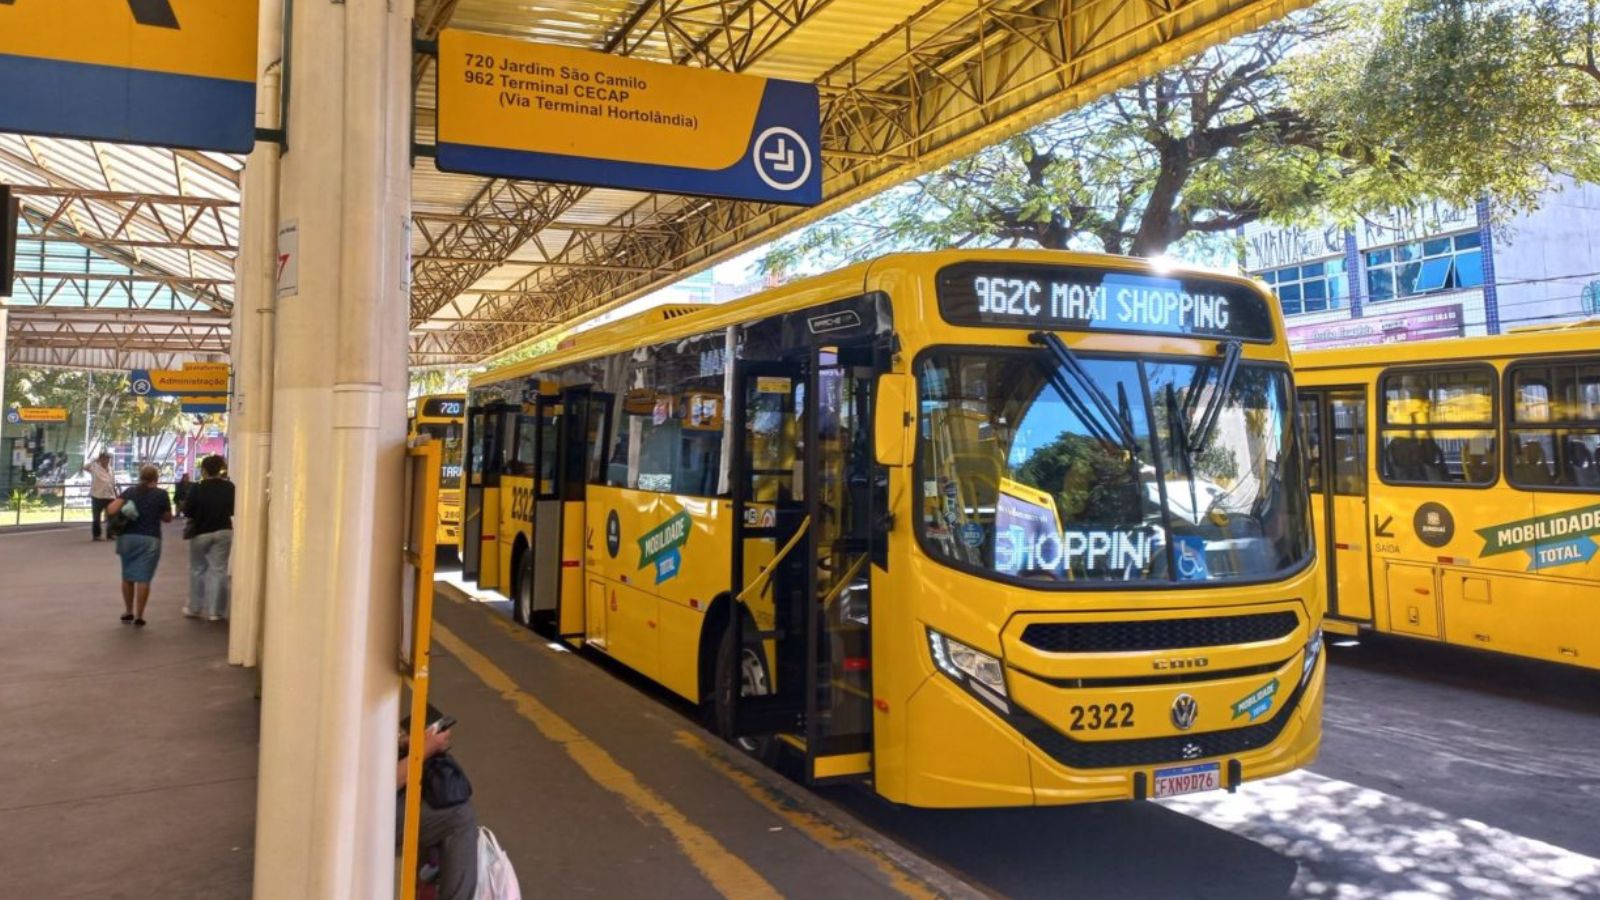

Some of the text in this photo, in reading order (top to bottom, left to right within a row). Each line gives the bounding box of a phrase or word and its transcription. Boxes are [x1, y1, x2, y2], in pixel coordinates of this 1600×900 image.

[464, 70, 630, 103] 962 Terminal CECAP
[465, 53, 648, 90] 720 Jardim São Camilo
[499, 91, 698, 130] (Via Terminal Hortolândia)
[974, 276, 1230, 329] 962C MAXI SHOPPING
[159, 377, 226, 387] Administração
[440, 402, 460, 414] 720
[1497, 510, 1600, 547] MOBILIDADE
[1538, 545, 1582, 564] TOTAL
[1152, 657, 1209, 670] CAIO
[1069, 702, 1135, 732] 2322
[1160, 773, 1214, 795] FXN9D76
